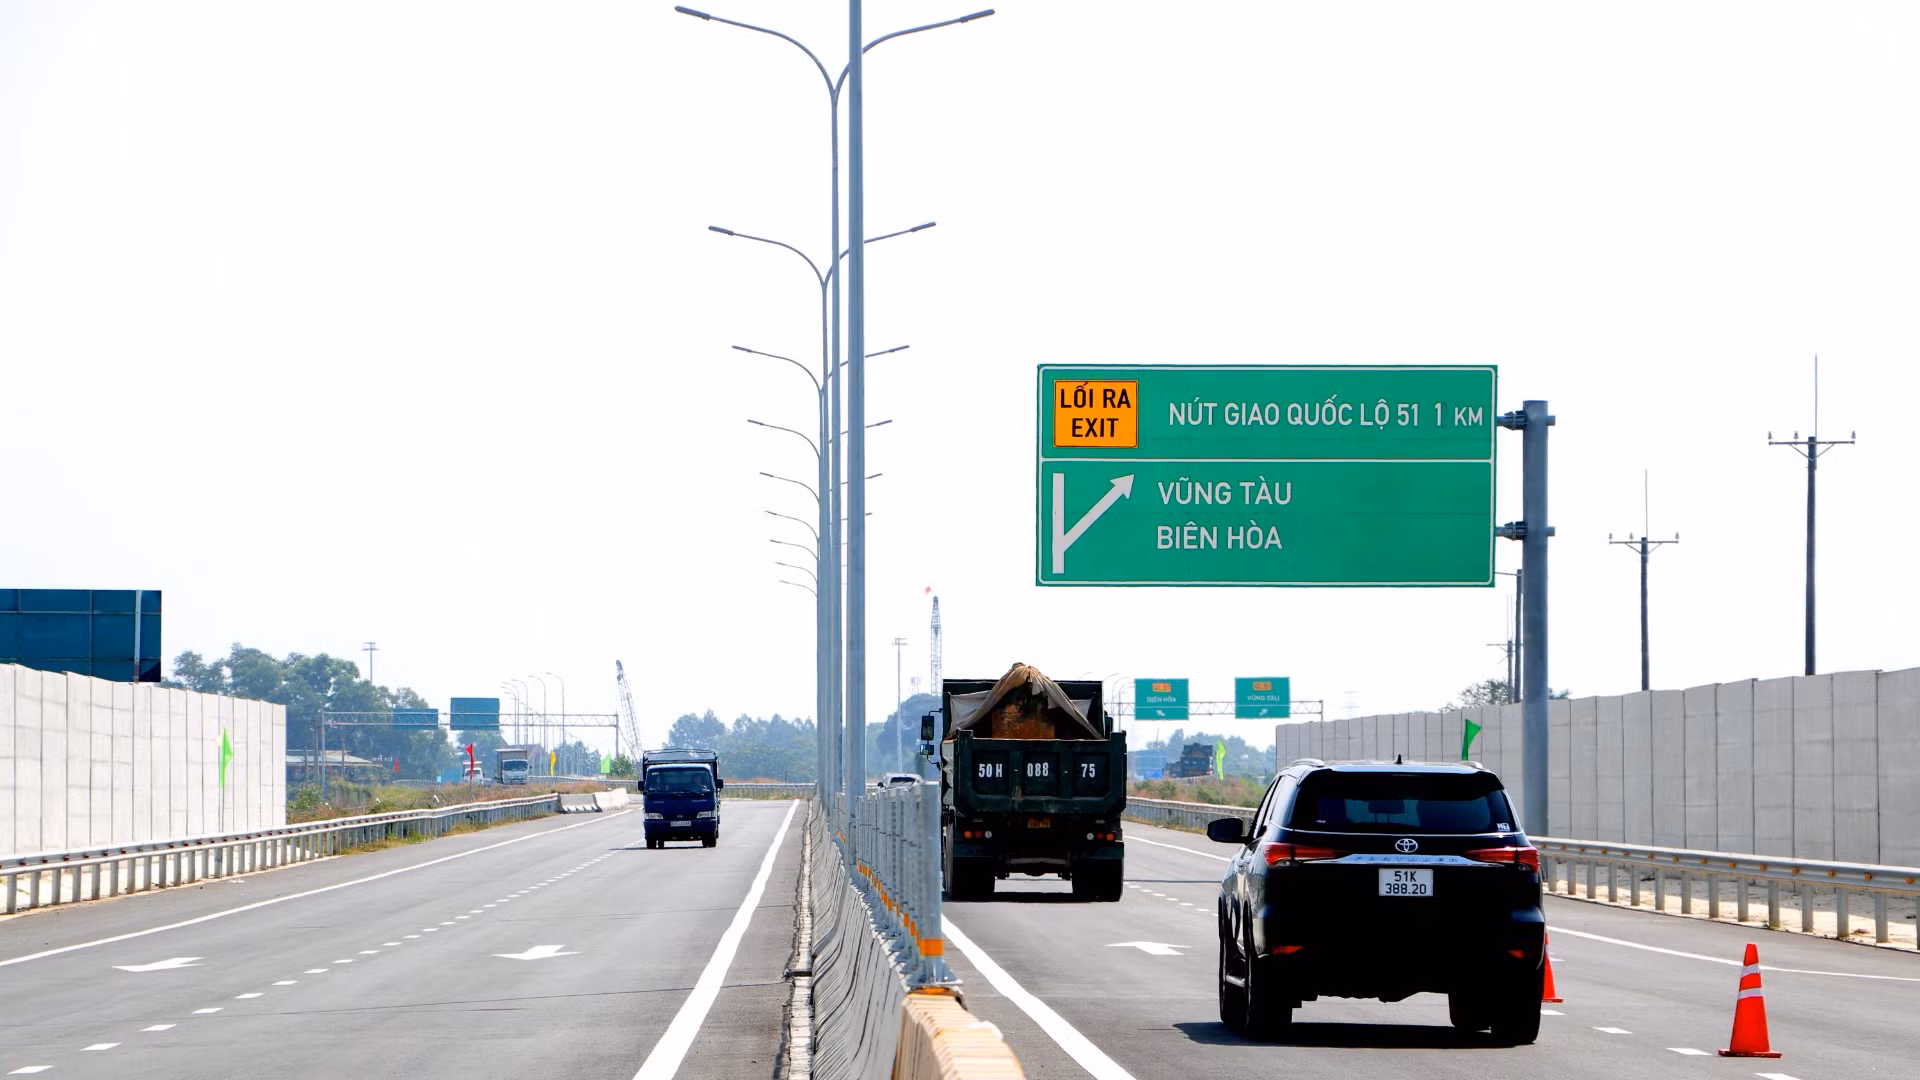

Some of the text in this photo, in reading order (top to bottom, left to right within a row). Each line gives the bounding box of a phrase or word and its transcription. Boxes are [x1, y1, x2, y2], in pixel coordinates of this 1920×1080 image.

[1060, 382, 1131, 408] LỐI RA
[1169, 394, 1483, 430] NÚT GIAO QUỐC LỘ 51 1 KM
[1071, 418, 1119, 437] EXIT
[1157, 475, 1292, 505] VŨNG TÀU
[1157, 520, 1283, 550] BIÊN HÒA
[1027, 762, 1049, 777] 088
[1081, 763, 1096, 778] 75
[1394, 870, 1417, 882] 51K
[1385, 883, 1427, 895] 388.20
